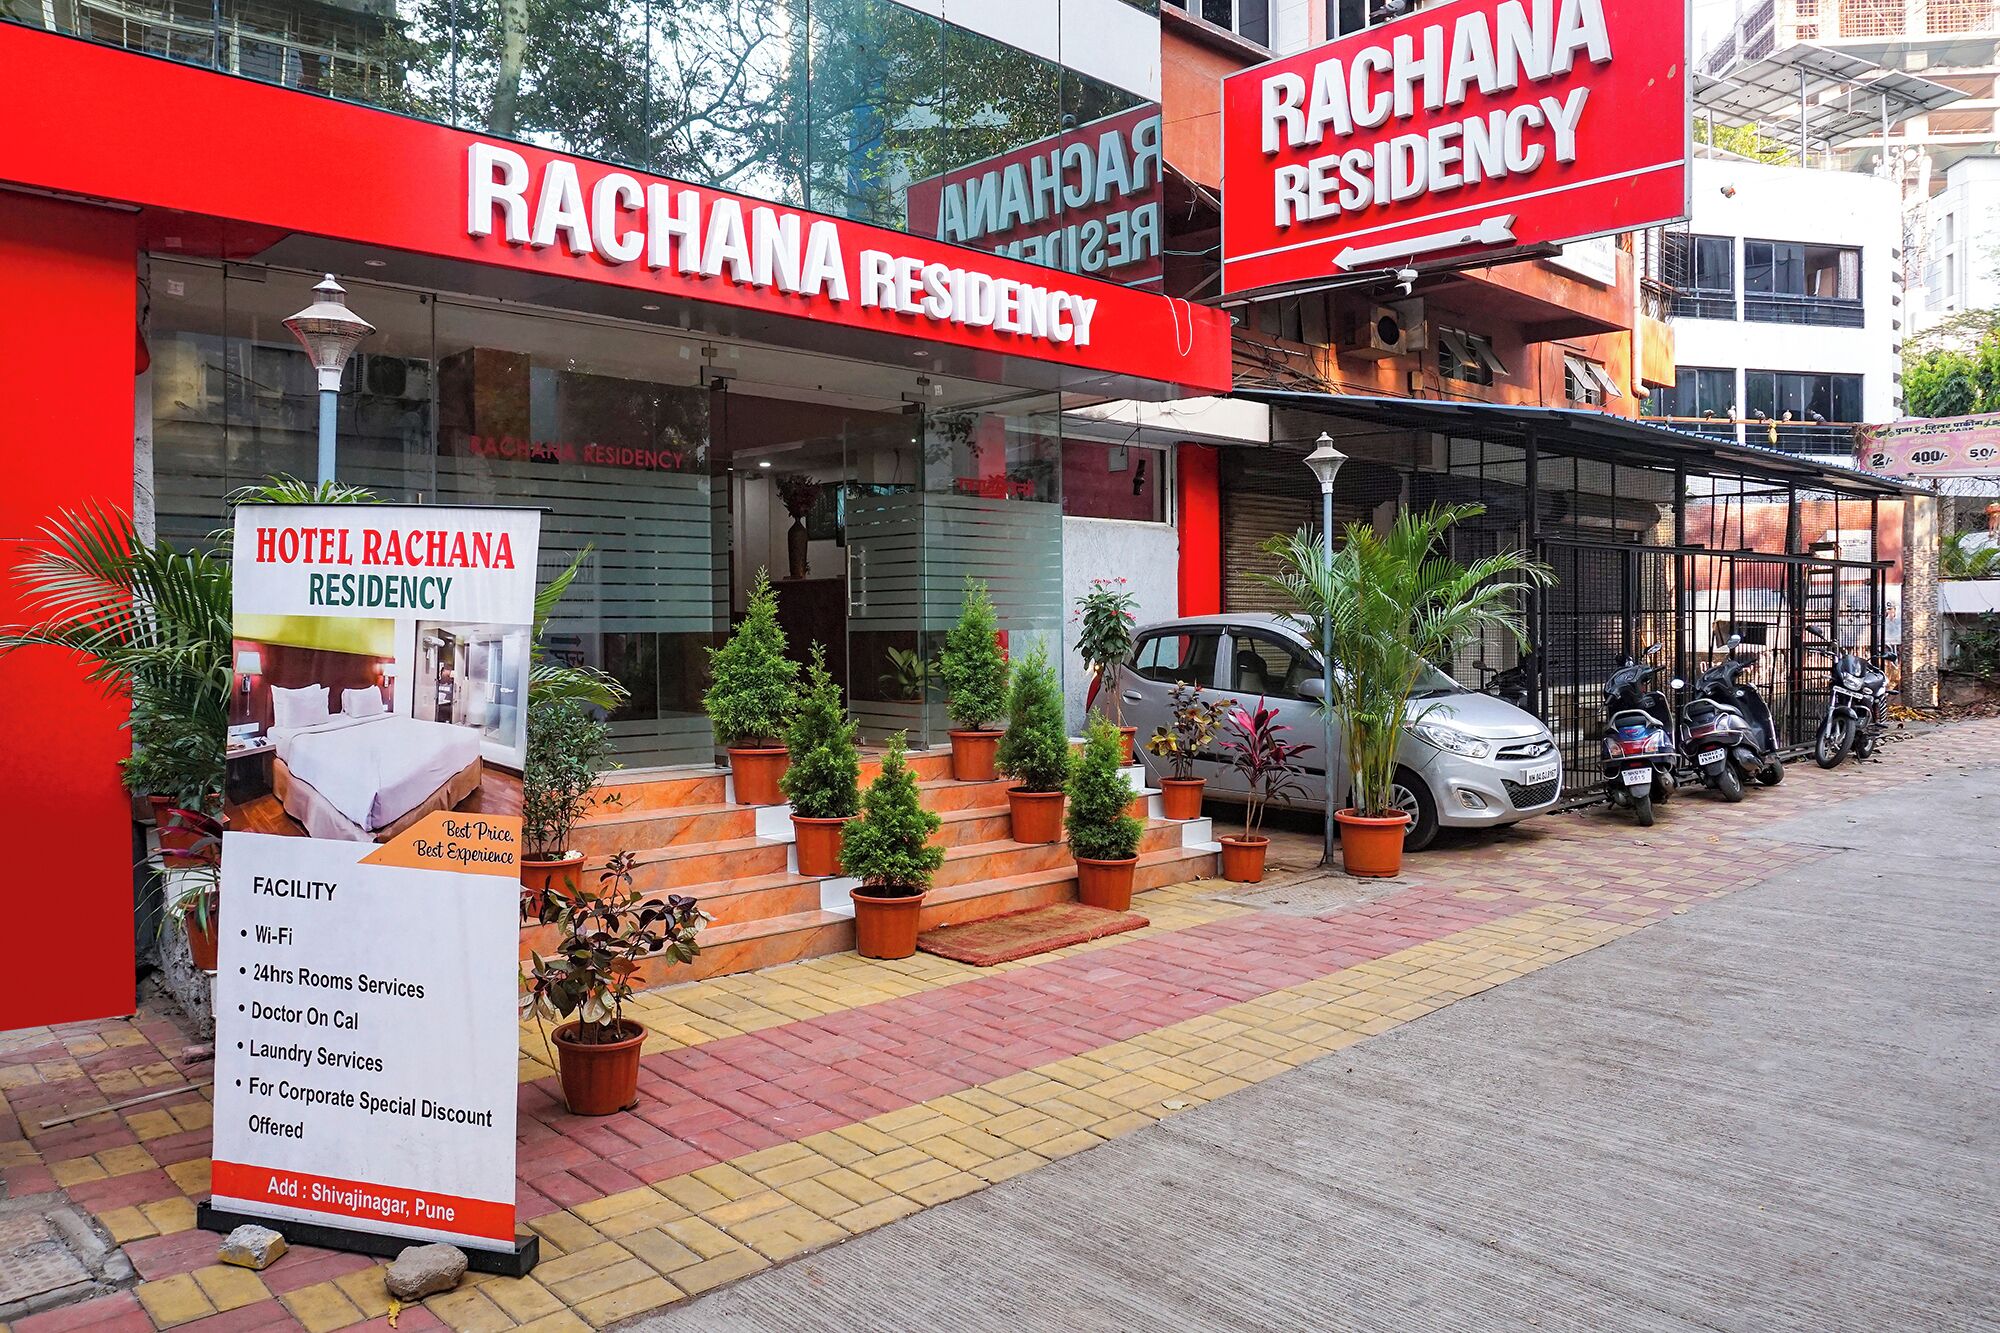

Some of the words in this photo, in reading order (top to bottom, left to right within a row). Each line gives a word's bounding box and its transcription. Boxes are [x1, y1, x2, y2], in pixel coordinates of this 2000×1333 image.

[1261, 0, 1613, 155] RACHANA
[1274, 86, 1591, 229] RESIDENCY
[467, 141, 850, 302] RACHANA
[859, 248, 1098, 347] RESIDENCY
[1949, 426, 1975, 434] PARK
[468, 434, 578, 464] RACHANA
[583, 446, 684, 470] RESIDENCY
[1911, 450, 1948, 463] 400/-
[256, 527, 353, 566] HOTEL
[361, 529, 515, 569] RACHANA
[309, 573, 453, 610] RESIDENCY
[442, 820, 472, 839] Best
[413, 839, 444, 859] Best
[447, 842, 515, 866] Experience
[253, 876, 338, 901] FACILITY
[255, 924, 293, 946] Wi-Fi
[253, 963, 294, 984] 24hrs
[298, 967, 353, 991] Rooms
[358, 974, 425, 999] Services
[251, 1001, 303, 1024] Doctor
[306, 1006, 329, 1027] On
[333, 1010, 359, 1030] Cal
[249, 1039, 313, 1068] Laundry
[316, 1046, 383, 1072] Services
[249, 1077, 274, 1096] For
[278, 1080, 355, 1107] Corporate
[359, 1091, 416, 1116] Special
[421, 1099, 493, 1127] Discount
[249, 1114, 304, 1139] Offered
[267, 1176, 298, 1198] Add
[311, 1182, 410, 1217] Shivajinagar,
[415, 1197, 455, 1221] Pune
